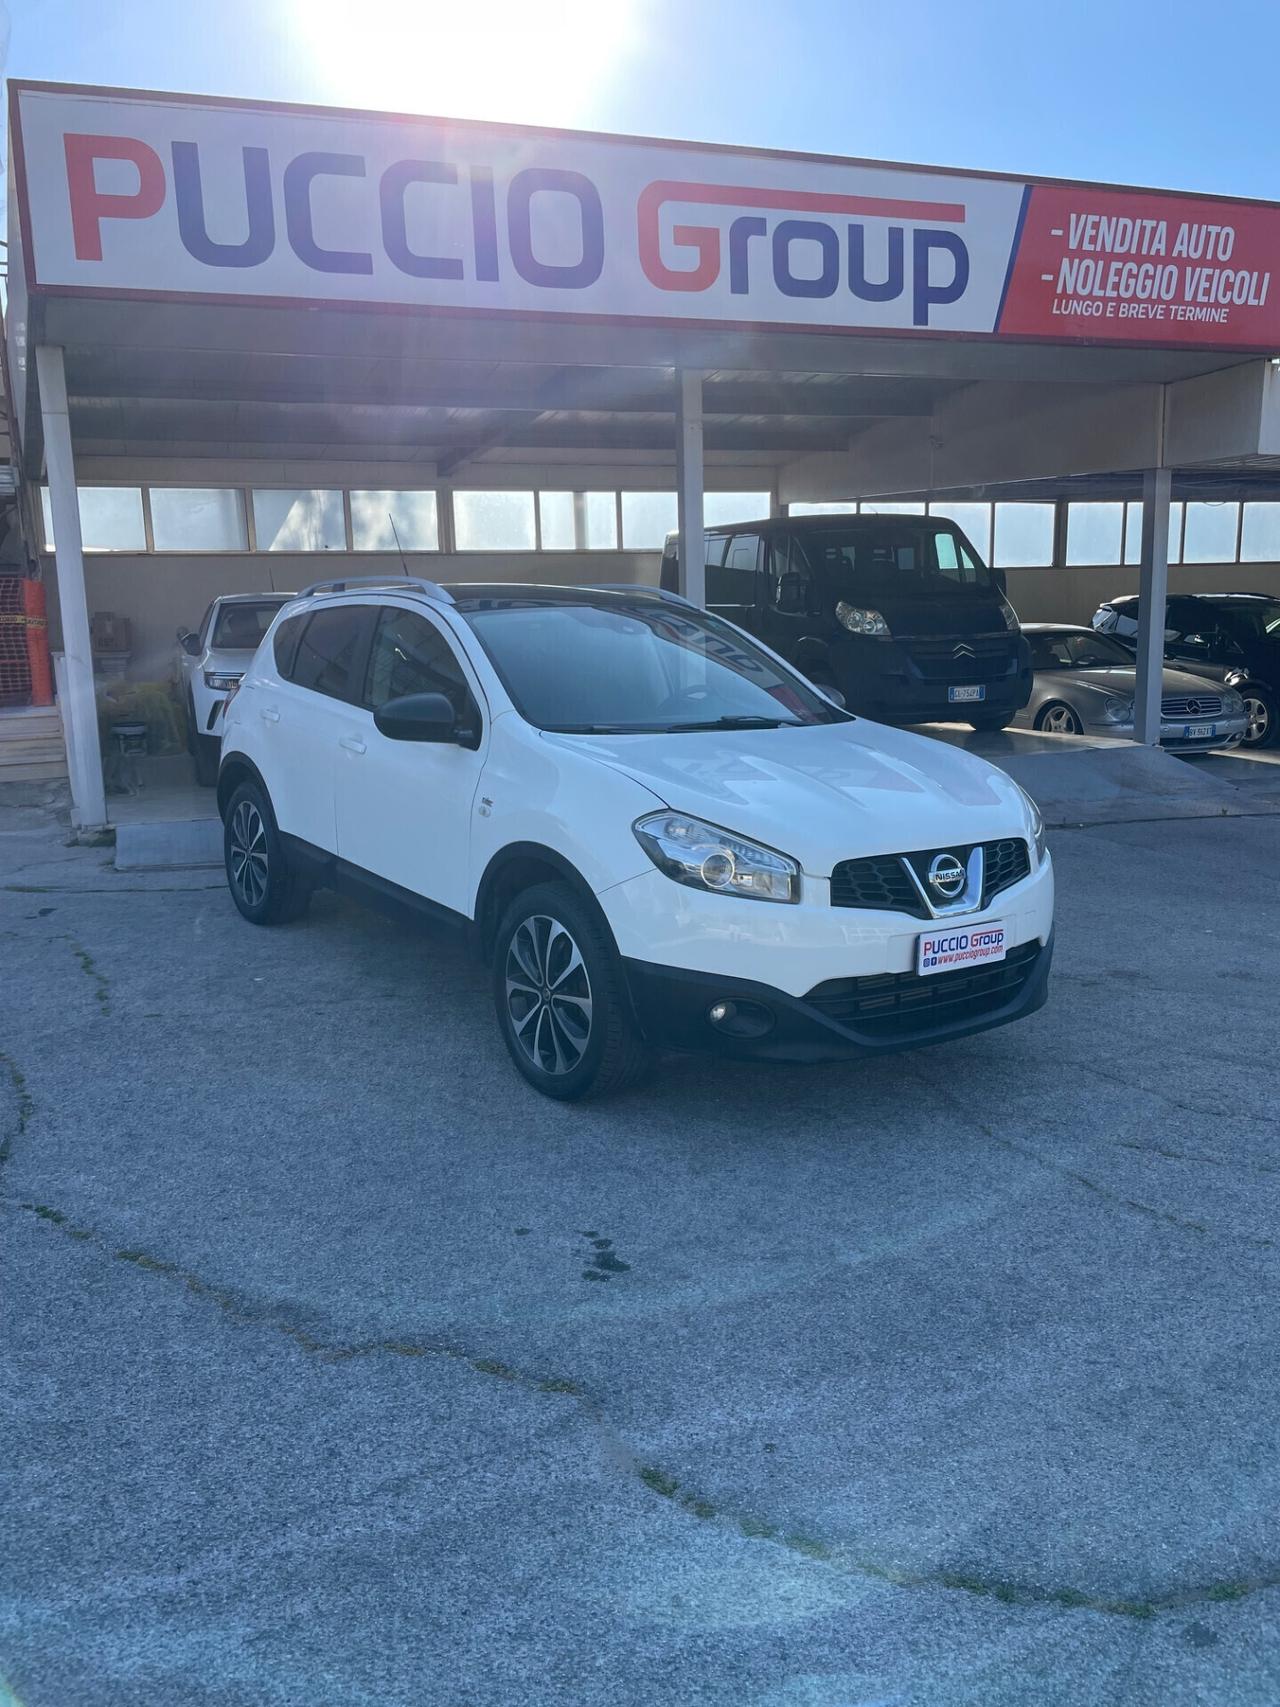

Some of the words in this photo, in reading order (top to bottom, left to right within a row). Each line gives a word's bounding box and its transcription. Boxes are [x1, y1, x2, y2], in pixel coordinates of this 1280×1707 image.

[63, 132, 605, 289] PUCCIO
[637, 180, 970, 326] Group
[1068, 213, 1168, 257] VENDITA
[1172, 223, 1235, 262] AUTO
[1056, 257, 1178, 301] NOLEGGIO
[1184, 266, 1271, 306] VEICOLI
[1052, 299, 1103, 317] LUNGO
[1106, 303, 1116, 317] E
[1118, 303, 1166, 319] BREVE
[1169, 305, 1230, 323] TERMINE
[923, 935, 969, 956] PUCCIO
[971, 929, 1004, 948] Group
[938, 945, 1004, 965] www.pucciogroup.com
